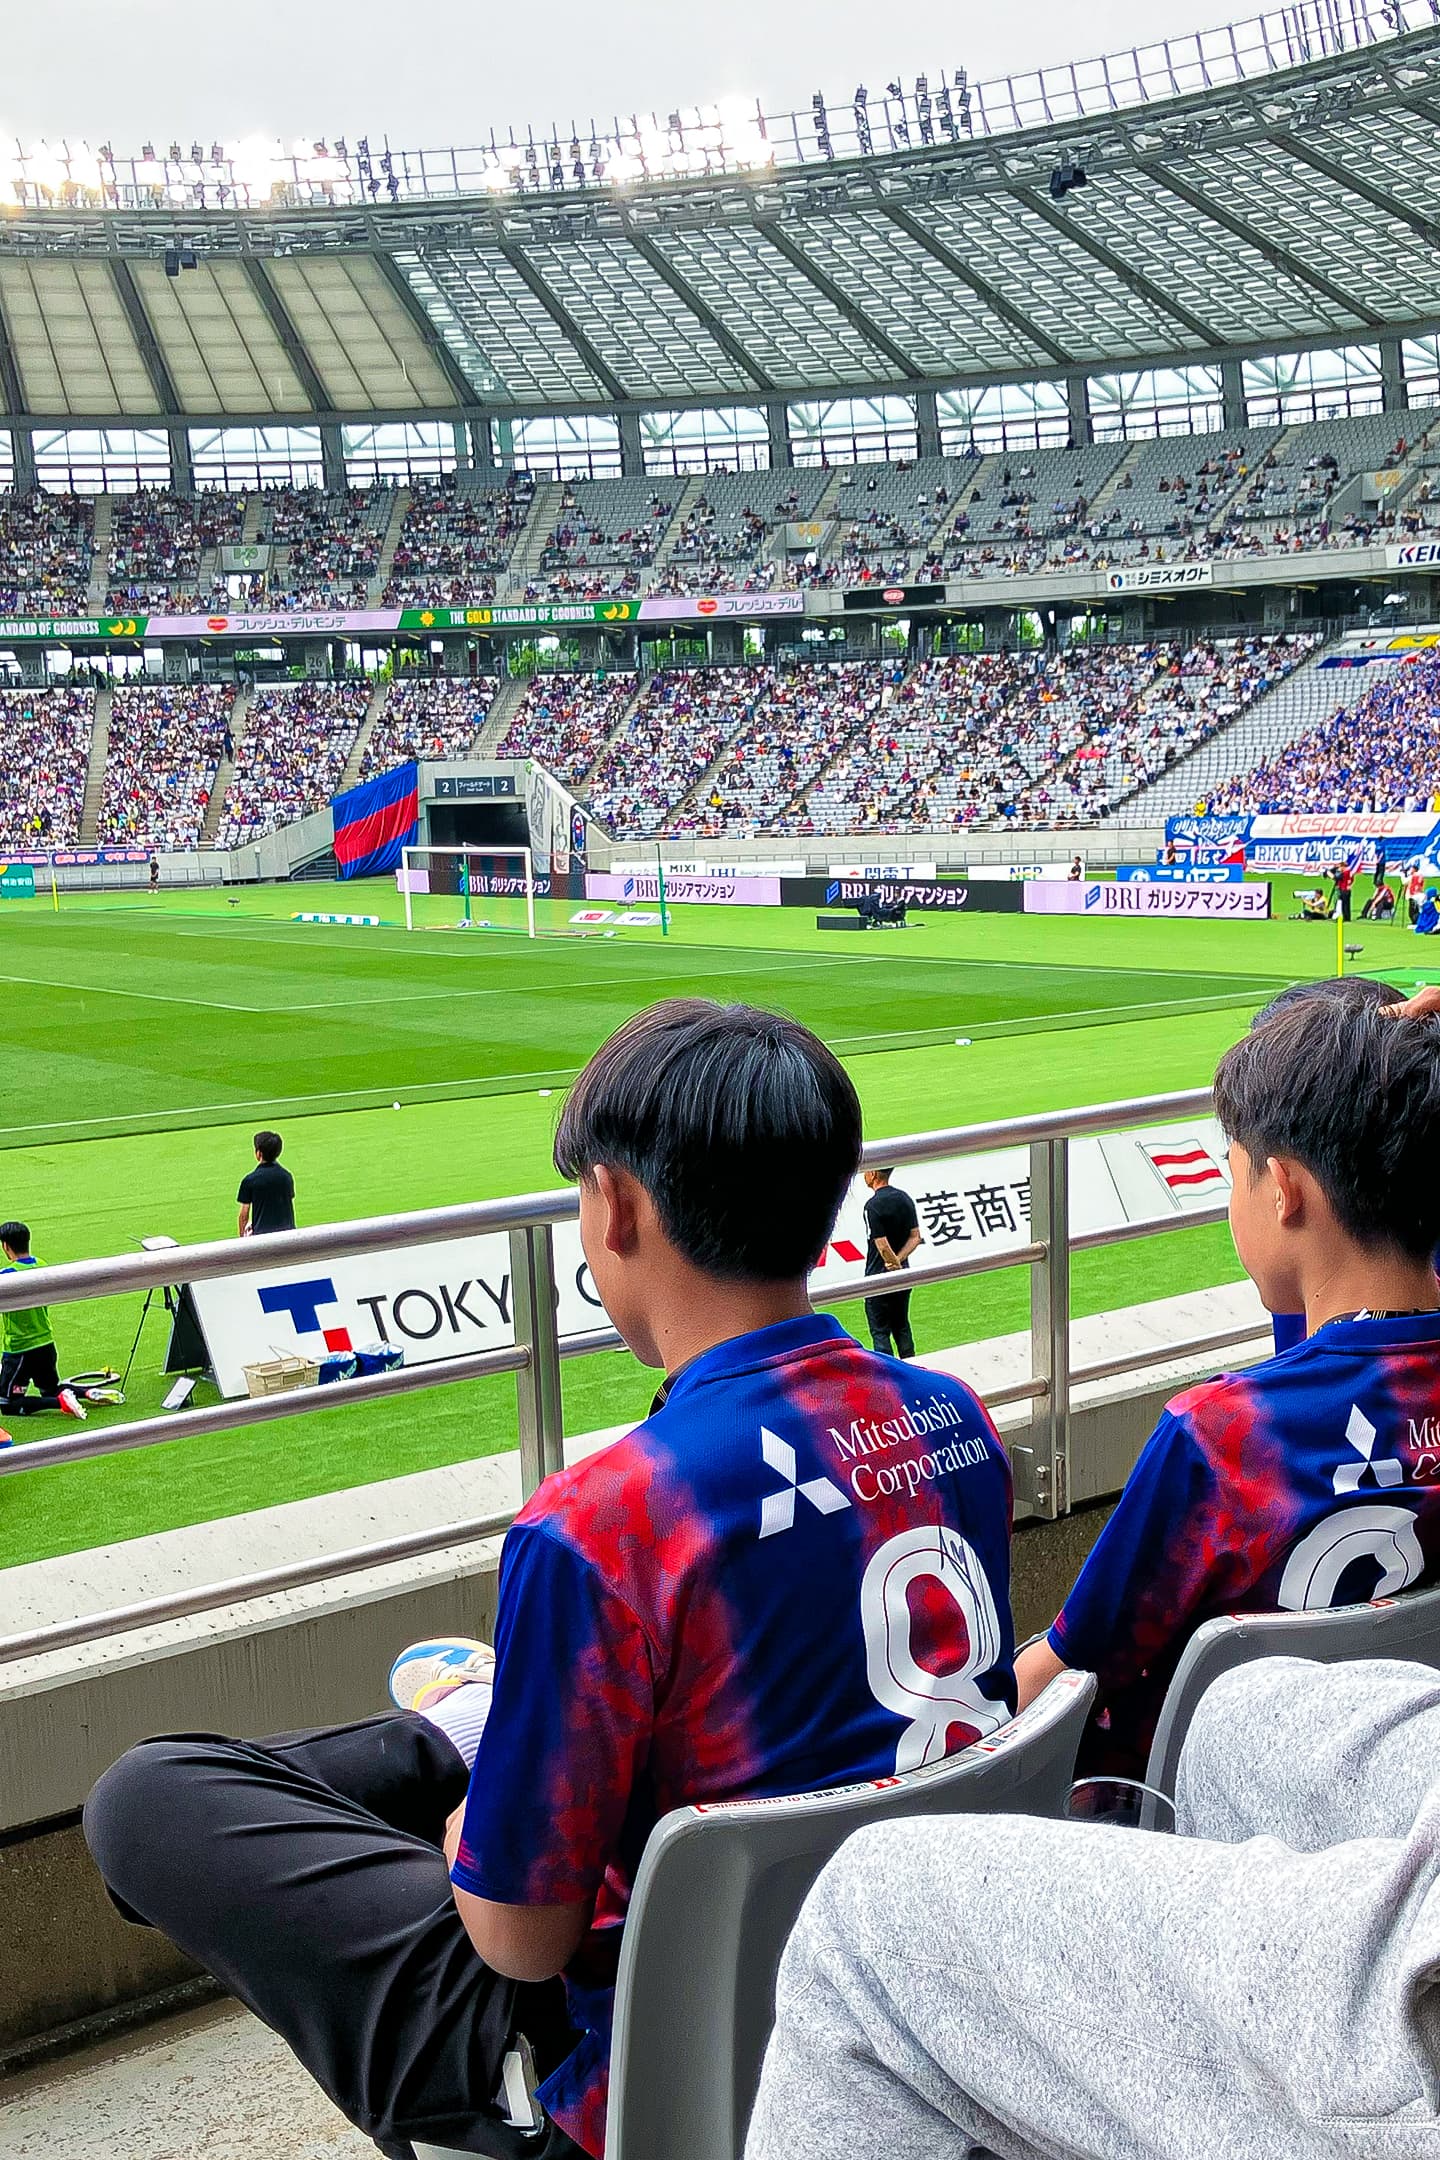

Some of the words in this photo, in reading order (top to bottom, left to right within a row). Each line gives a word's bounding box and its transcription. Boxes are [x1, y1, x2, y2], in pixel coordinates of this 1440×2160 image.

[1398, 545, 1440, 565] KEI
[1138, 567, 1209, 585] シミズオクト
[235, 616, 346, 631] フレッシュ・デルモンテ
[450, 611, 465, 625] THE
[466, 610, 491, 624] GOLD
[492, 607, 536, 623] STANDARD
[538, 607, 550, 621] OF
[551, 605, 595, 620] GOODNESS
[40, 621, 52, 635] OF
[53, 620, 100, 635] GOODNESS
[169, 660, 182, 672] 27
[308, 656, 323, 668] 26
[442, 782, 450, 793] 2
[501, 781, 509, 792] 2
[670, 865, 696, 873] MIXI
[469, 876, 489, 893] BRI
[635, 879, 658, 898] BRI
[1105, 887, 1141, 910] BRI
[1147, 889, 1268, 912] ガリシアマンション
[357, 1273, 559, 1343] TOKY
[827, 1393, 963, 1462] Mitsubishi
[851, 1432, 990, 1502] Corporation
